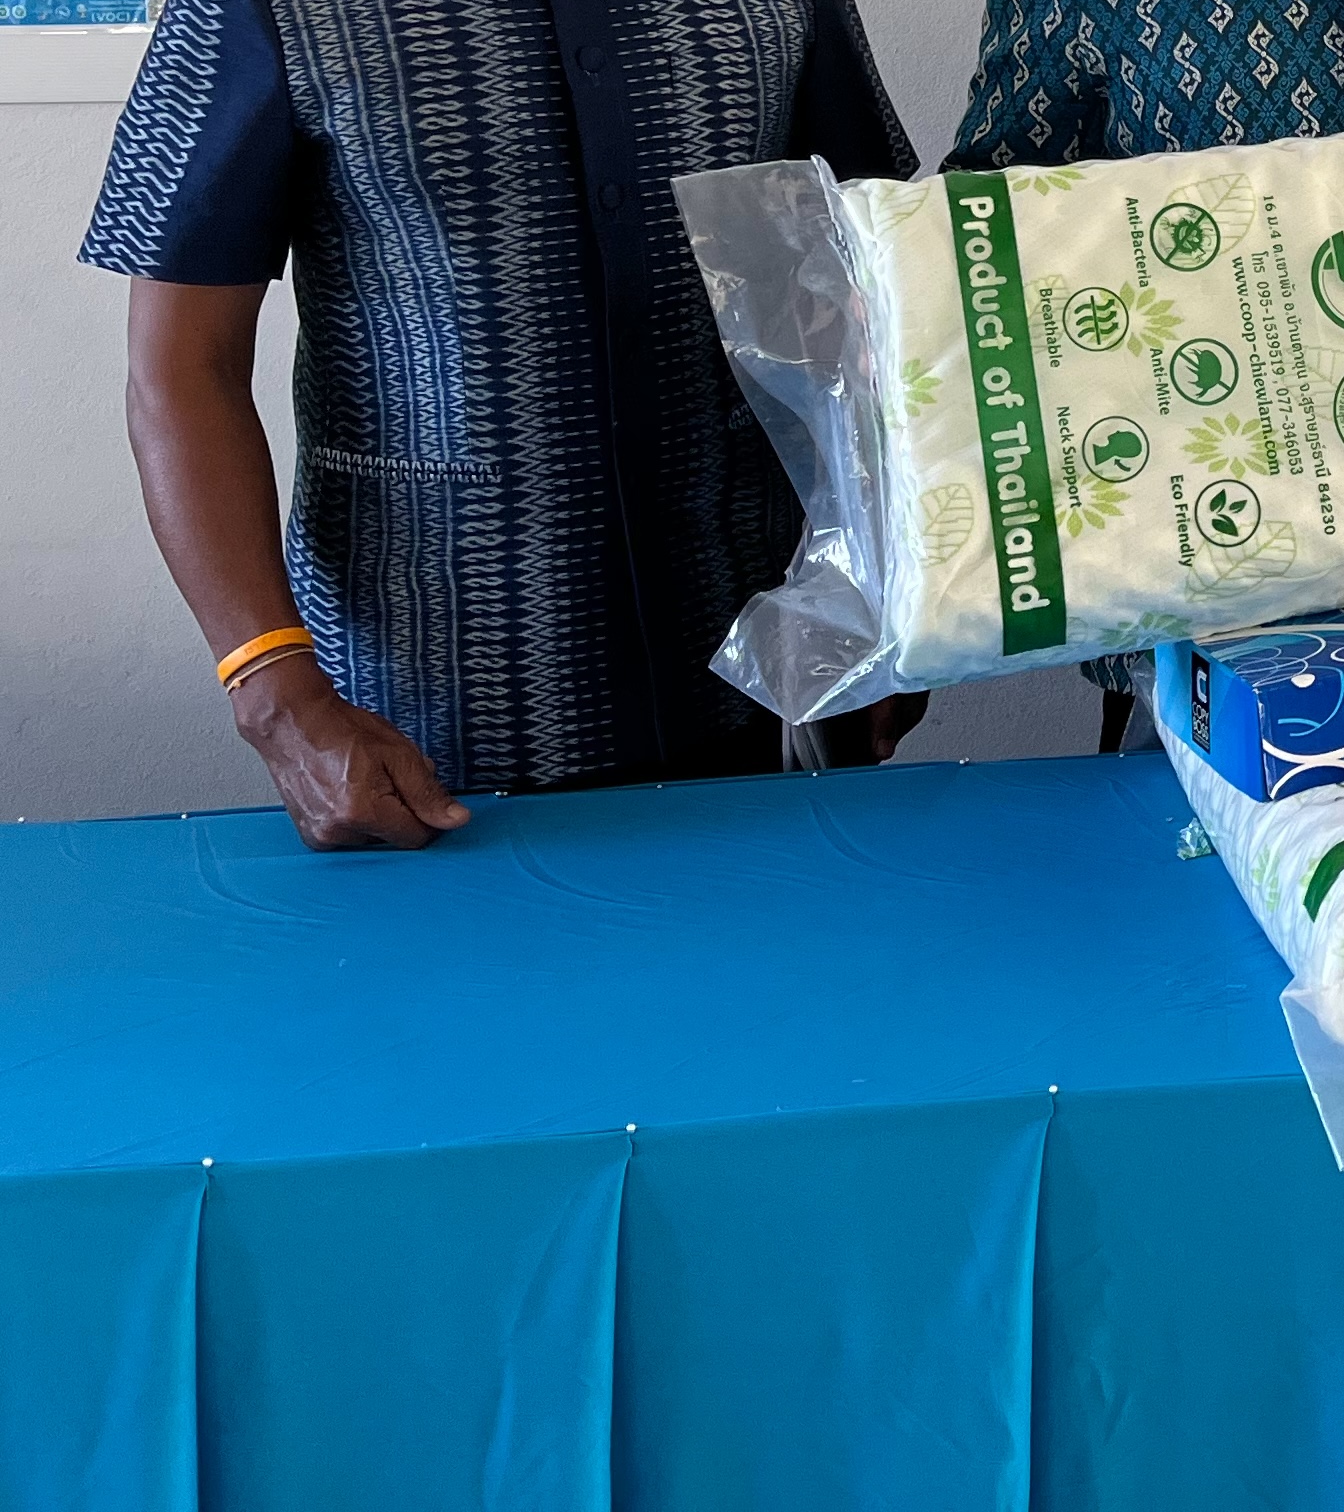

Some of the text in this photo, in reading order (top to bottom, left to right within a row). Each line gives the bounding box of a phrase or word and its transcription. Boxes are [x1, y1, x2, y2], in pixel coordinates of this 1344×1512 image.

[1124, 196, 1152, 288] Anti-Bacteria
[1039, 286, 1065, 369] Breathable
[1229, 255, 1284, 477] www.coop-chiewlarn.com
[1262, 195, 1277, 213] 16
[1317, 482, 1337, 536] 84230
[957, 195, 1050, 613] Product of Thailand
[1148, 345, 1173, 416] Anti-Mite
[1056, 405, 1085, 510] Neck Support
[1275, 388, 1304, 476] 077-346053
[1170, 473, 1197, 568] Eco Friendly
